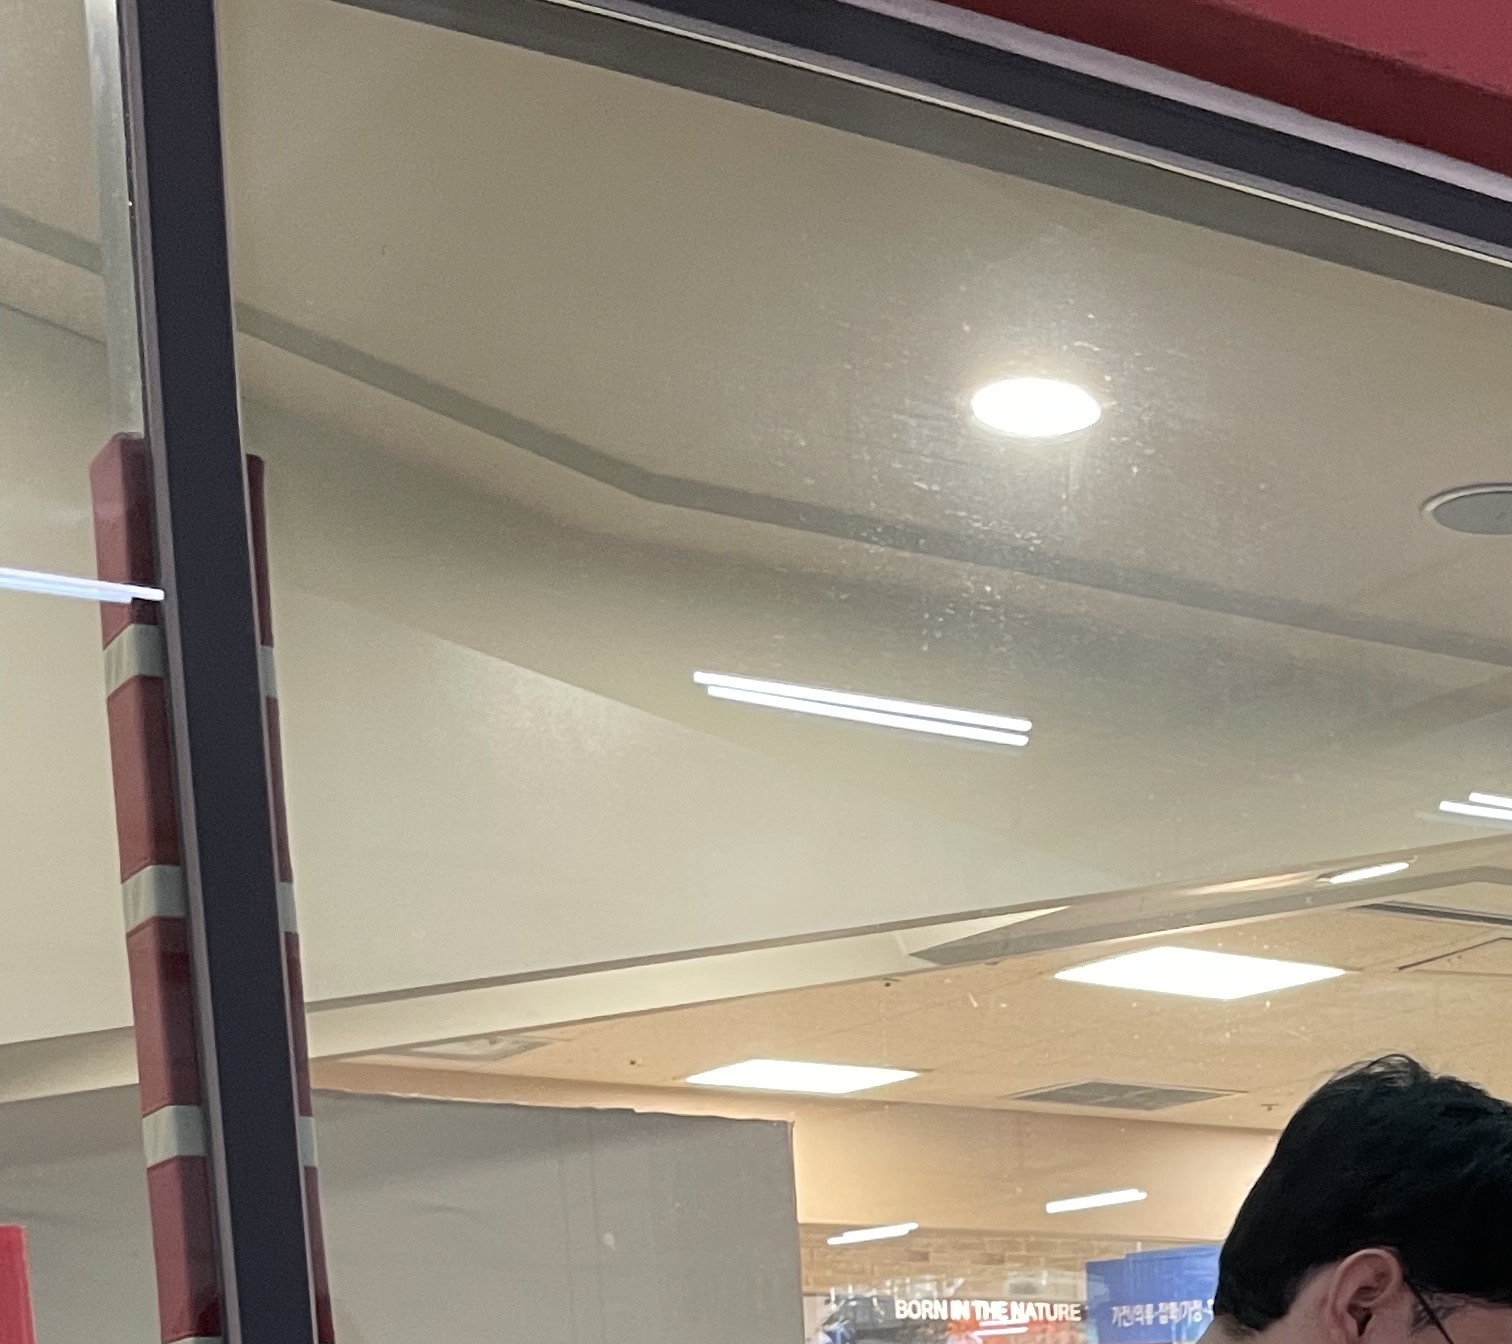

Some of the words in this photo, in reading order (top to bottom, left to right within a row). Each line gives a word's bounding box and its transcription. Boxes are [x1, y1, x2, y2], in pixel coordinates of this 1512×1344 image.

[894, 1299, 948, 1320] BORN
[950, 1300, 971, 1320] IN
[971, 1300, 1009, 1321] THE
[1010, 1301, 1082, 1321] NATURE
